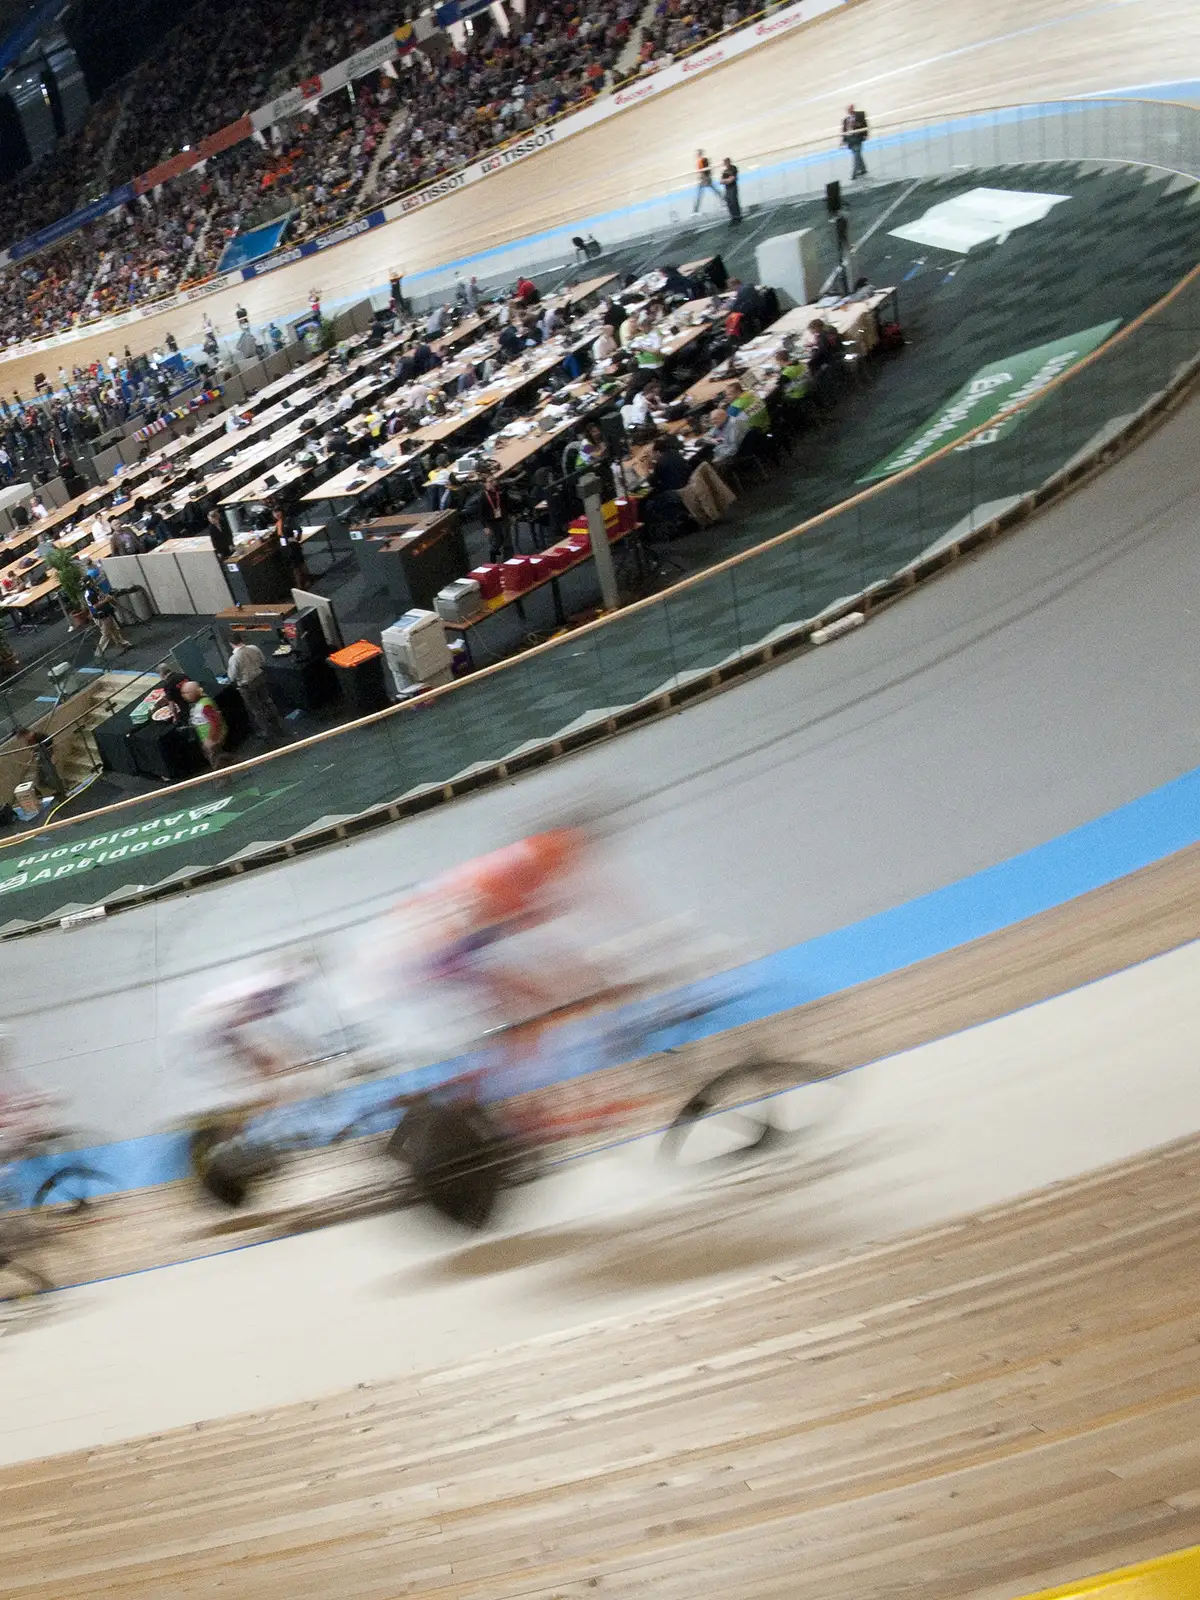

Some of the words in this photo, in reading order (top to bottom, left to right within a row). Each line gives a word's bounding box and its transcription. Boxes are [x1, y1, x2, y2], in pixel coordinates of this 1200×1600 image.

[500, 129, 555, 163] TISSOT
[419, 172, 466, 202] TISSOT
[315, 218, 370, 250] SHIMANO
[253, 248, 302, 274] SHIMANO
[17, 813, 185, 868] Apeldoorn
[30, 822, 210, 883] Apeldoorn
